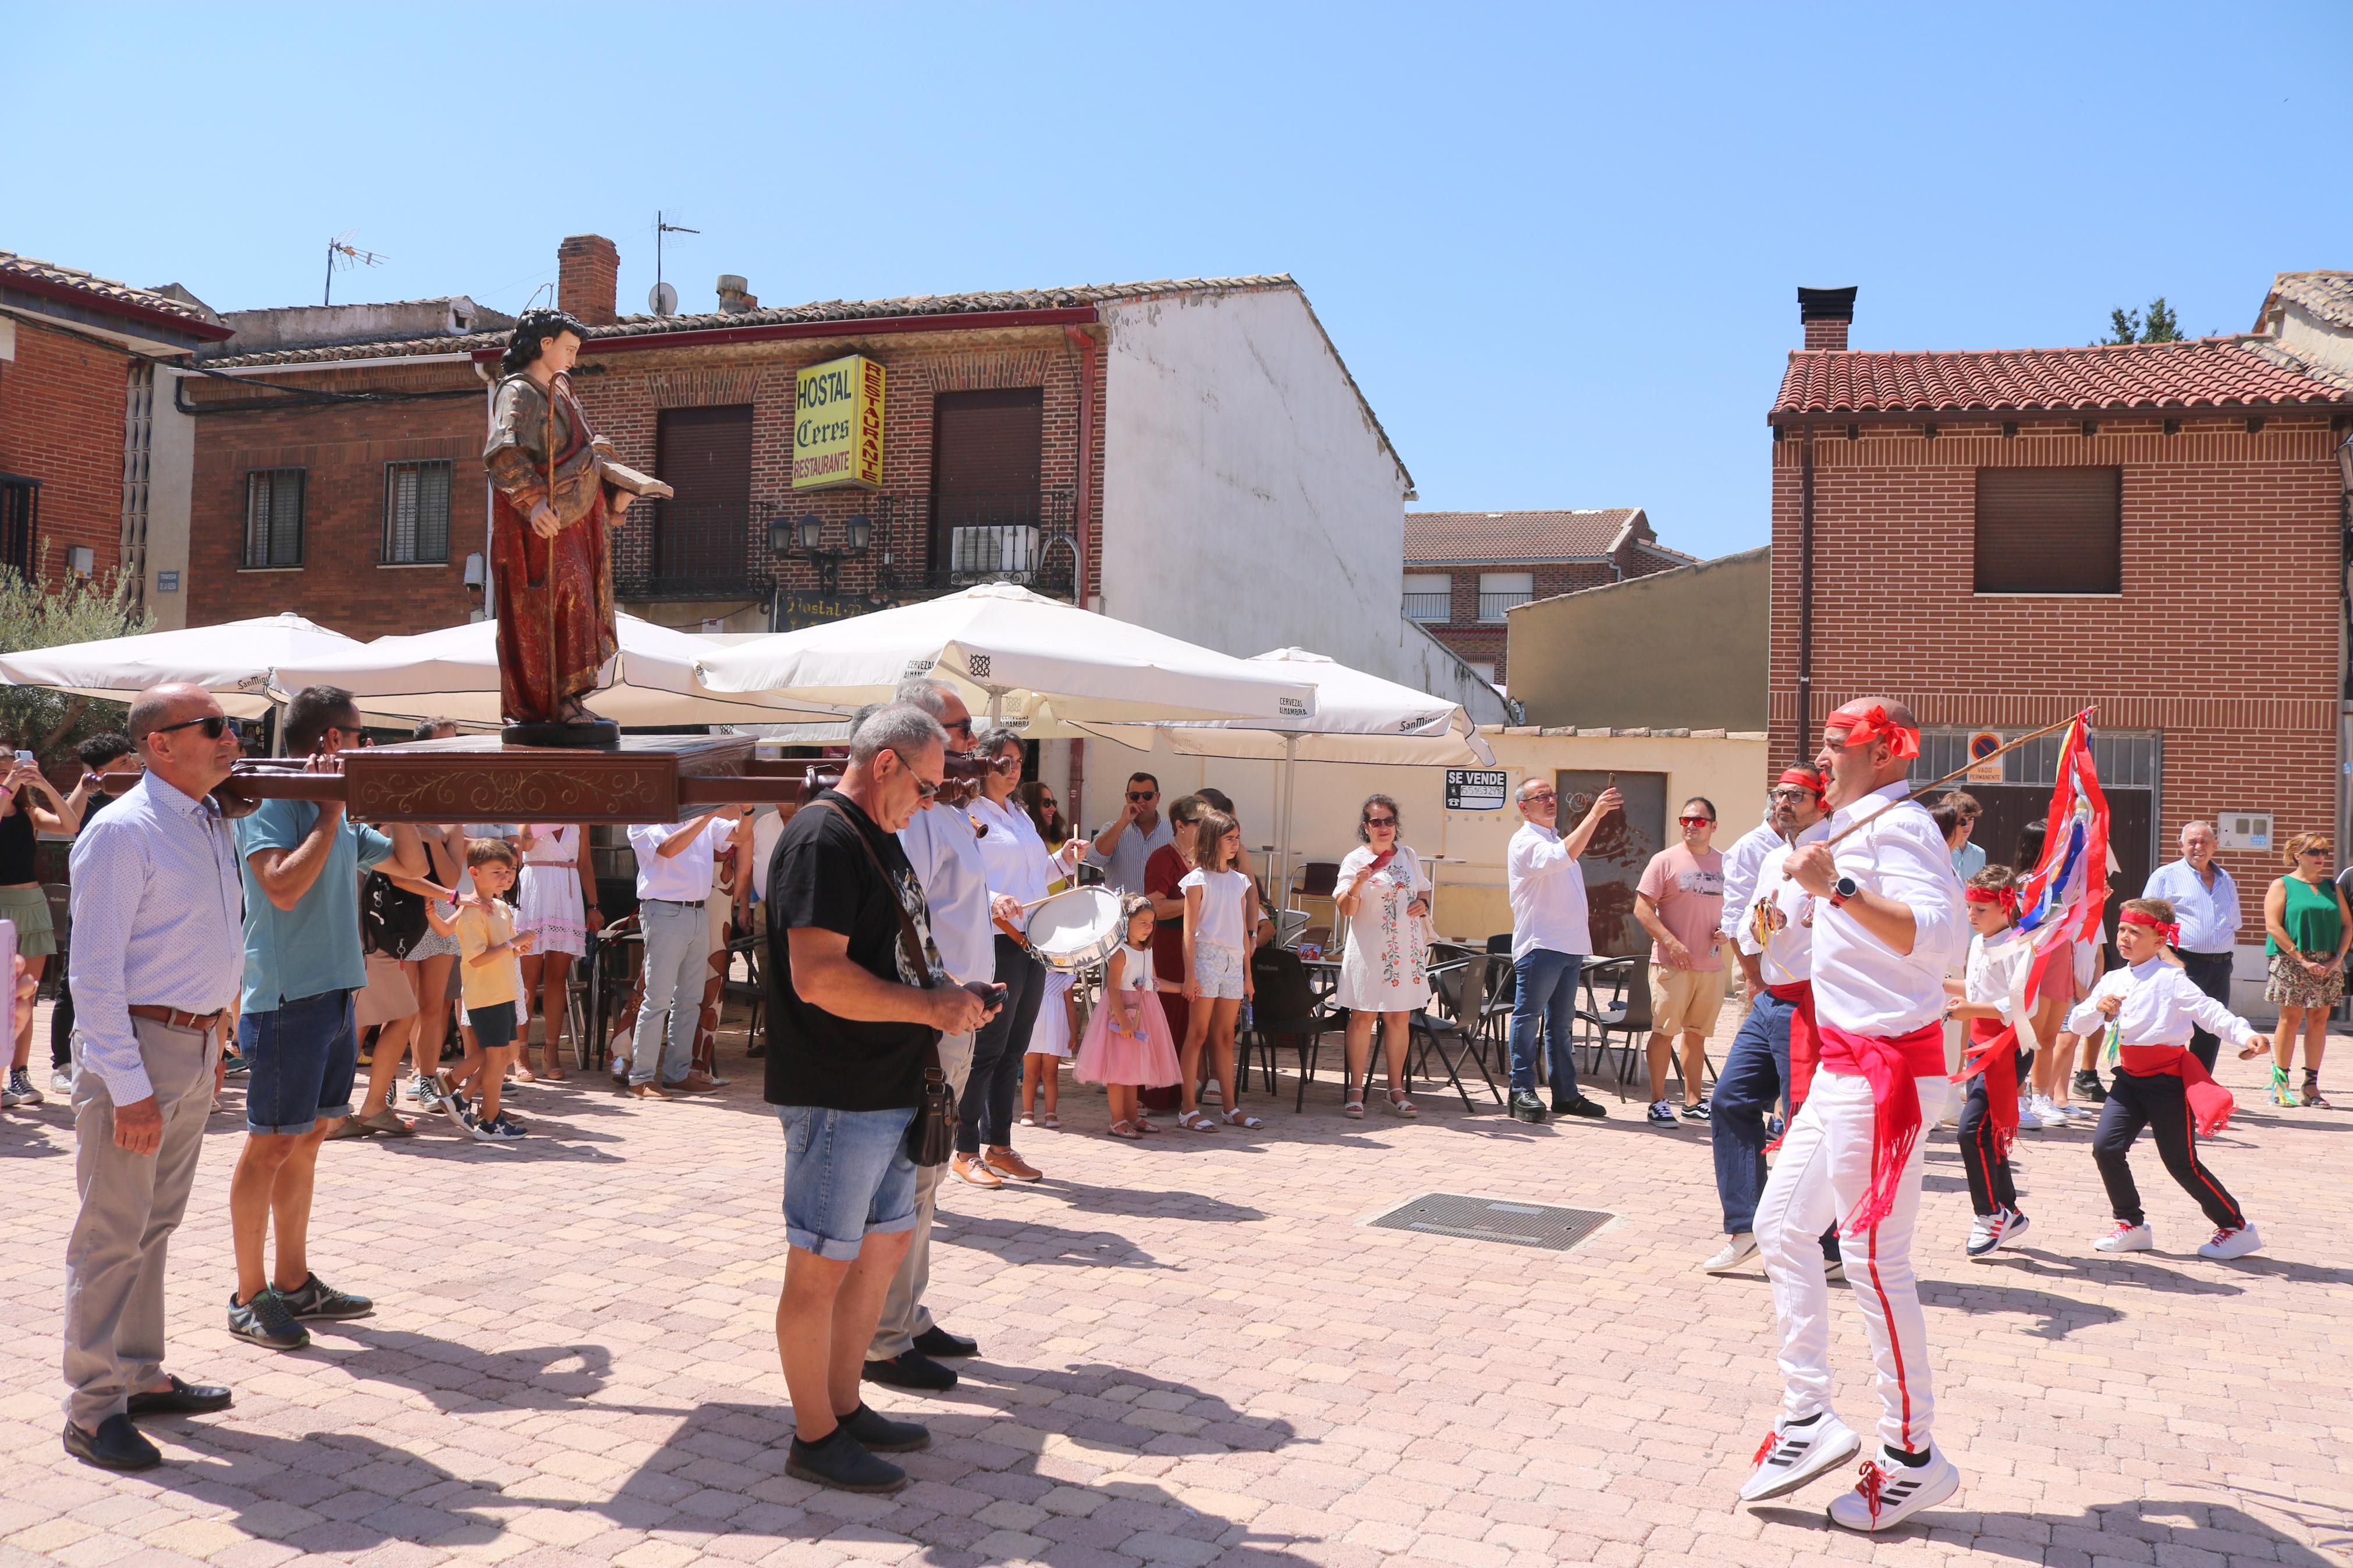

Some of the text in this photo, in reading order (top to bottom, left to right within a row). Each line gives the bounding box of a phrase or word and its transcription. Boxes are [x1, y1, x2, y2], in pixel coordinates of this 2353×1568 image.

[797, 369, 851, 410] HOSTAL
[862, 361, 881, 483] RESTAURANTE
[797, 419, 849, 447] Ceres
[794, 450, 850, 479] RESTAURANTE
[1279, 706, 1307, 716] ALHAMBRA
[1280, 697, 1303, 707] CERVEZAS
[1448, 771, 1504, 785] SE VENDE
[1461, 786, 1504, 795] 651632496
